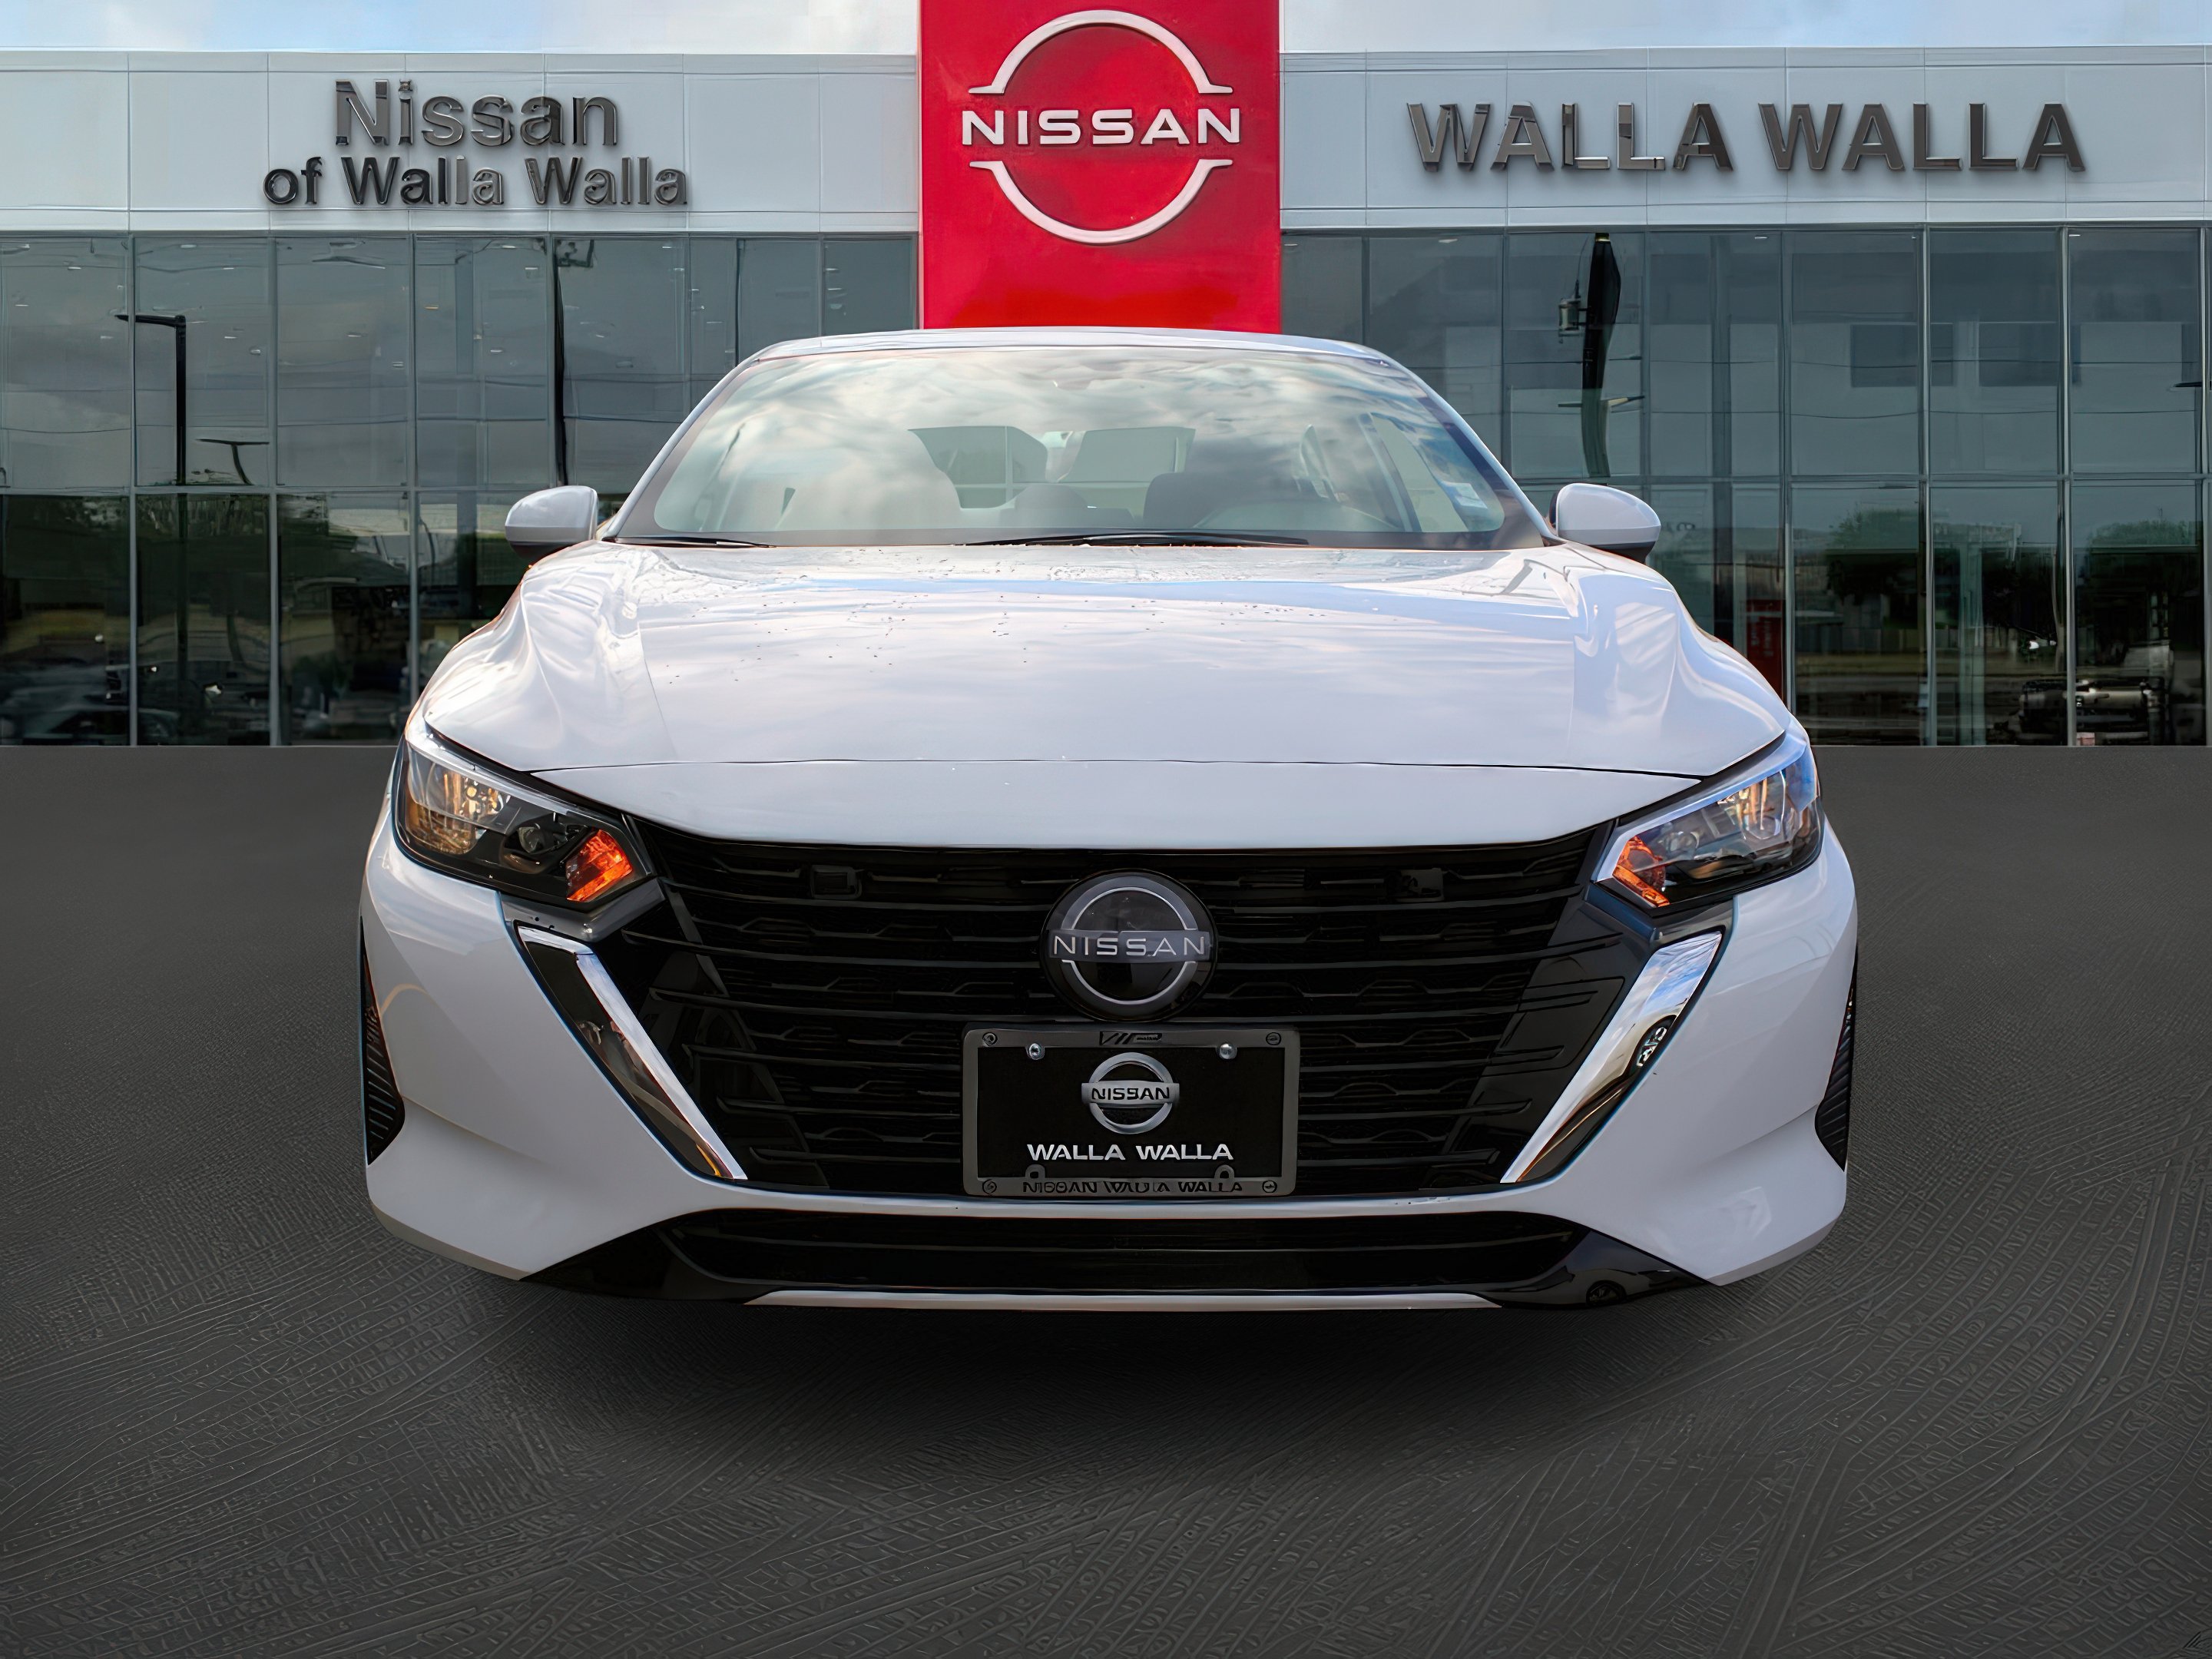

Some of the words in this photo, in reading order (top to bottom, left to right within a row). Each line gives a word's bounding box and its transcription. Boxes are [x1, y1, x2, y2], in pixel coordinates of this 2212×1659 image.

[334, 78, 618, 147] Nissan
[962, 108, 1240, 145] NISSAN
[1406, 101, 1735, 173] WALLA
[1757, 101, 2086, 173] WALLA
[262, 156, 323, 205] of
[340, 155, 505, 205] Walla
[524, 156, 688, 205] Walla
[1053, 935, 1206, 957] NISSAN
[1091, 1087, 1171, 1101] NISSAN
[1027, 1144, 1126, 1161] WALLA
[1135, 1144, 1234, 1161] WALLA
[1177, 1181, 1243, 1194] WALLA
